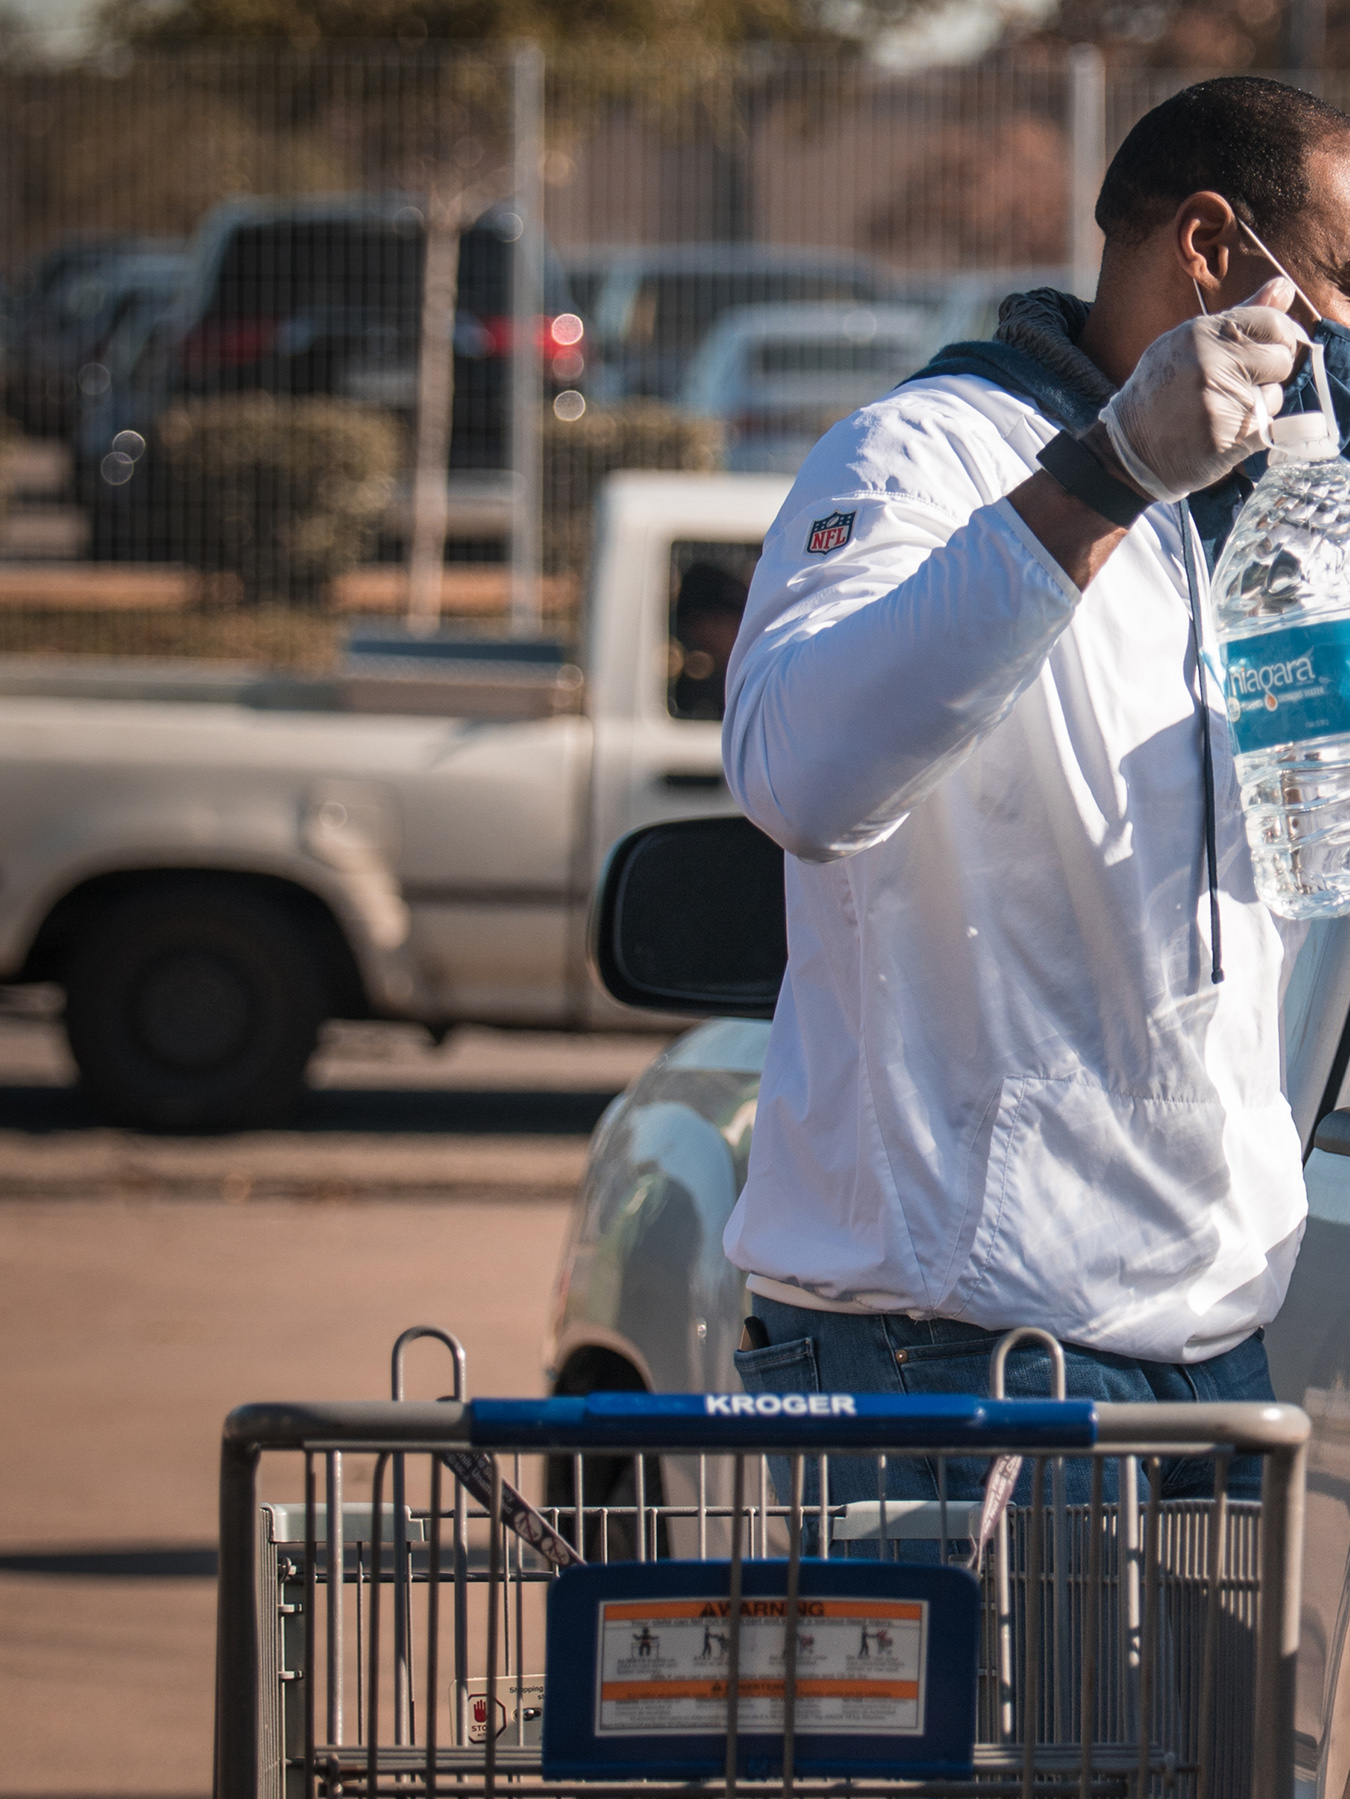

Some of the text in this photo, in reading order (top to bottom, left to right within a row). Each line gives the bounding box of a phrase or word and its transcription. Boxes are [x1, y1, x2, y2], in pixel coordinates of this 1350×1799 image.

[811, 527, 846, 549] NFL
[1230, 657, 1316, 706] niagara
[706, 1394, 857, 1416] KROGER
[716, 1602, 825, 1617] WARNNG
[471, 1724, 488, 1733] STO
